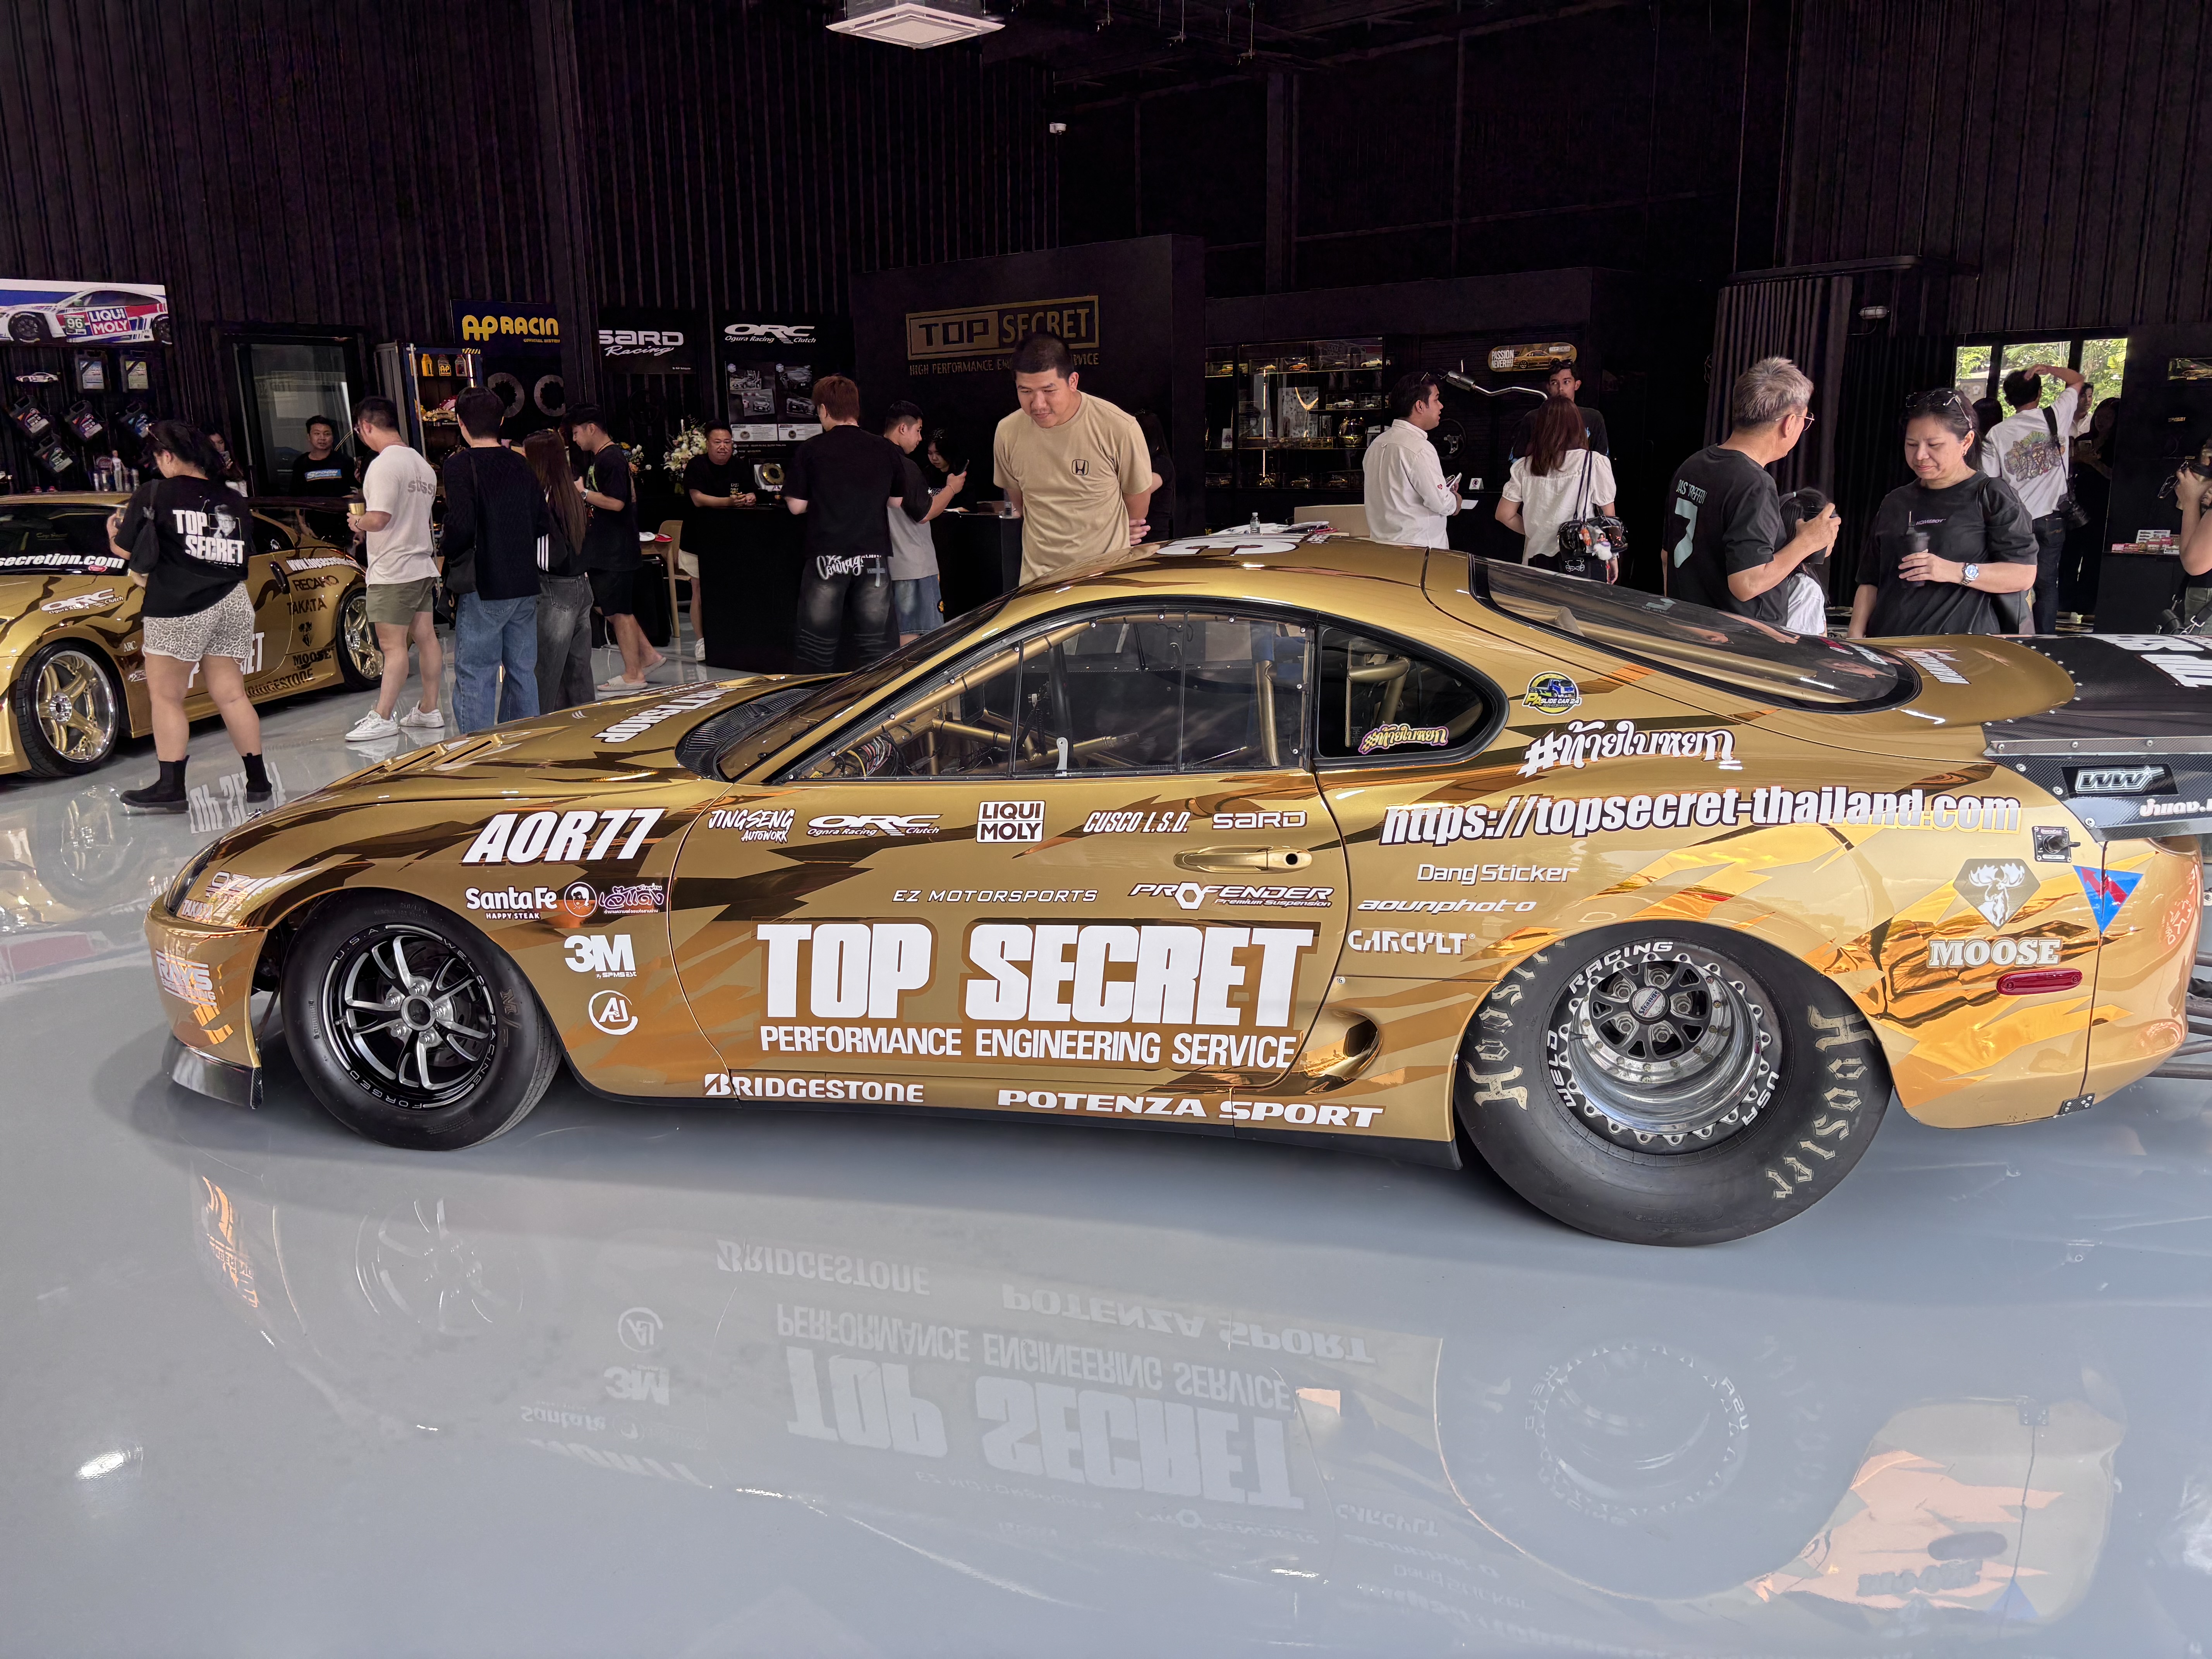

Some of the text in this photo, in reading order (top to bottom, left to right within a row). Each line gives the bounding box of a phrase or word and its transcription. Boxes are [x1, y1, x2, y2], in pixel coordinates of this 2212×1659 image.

[67, 318, 83, 329] 96
[89, 308, 126, 322] LIQUI
[92, 320, 128, 335] MOLY
[462, 315, 559, 341] AP RACIN
[725, 324, 815, 338] ORC
[919, 308, 1090, 346] TOP SECRET
[604, 345, 675, 356] Racing
[1492, 350, 1514, 360] PASSION
[910, 364, 929, 376] HIGH
[932, 360, 994, 374] PERFORMANCE
[1491, 359, 1506, 368] NEVER
[1676, 479, 1688, 495] DAS
[172, 510, 208, 536] TOP
[1674, 497, 1698, 568] 7
[185, 535, 245, 564] SECRET
[291, 575, 340, 592] RECARO
[287, 598, 328, 616] TAKATA
[124, 641, 137, 653] ARC
[292, 650, 332, 666] MOOSE
[708, 809, 795, 830] JINGSENG
[982, 803, 1042, 820] LIQUI
[1084, 811, 1193, 833] CUSCO L.S.D.
[1381, 786, 2021, 845] https://topsecret-thailand.com
[462, 808, 665, 864] AOR77
[808, 814, 943, 836] ORC
[841, 828, 878, 836] Racing
[906, 826, 940, 835] Clutch
[981, 822, 1041, 841] MOLY
[1416, 864, 1579, 885] Dang Sticker
[893, 889, 1098, 902] EZ MOTORSPORTS
[1263, 899, 1331, 908] Suspension
[1357, 898, 1537, 914] aounphoto
[563, 934, 636, 972] 3M
[1928, 939, 2061, 967] MOOSE
[156, 956, 213, 991] RAYS
[757, 923, 1314, 1027] TOP SECRET
[443, 938, 496, 1085] WELD RACING
[1638, 990, 1658, 1014] Strange
[1547, 941, 1673, 1109] WELD RACING
[760, 1025, 1297, 1069] PERFORMANCE ENGINEERING SERVICE
[349, 1069, 423, 1109] FORGED
[704, 1073, 925, 1103] BRIDGESTONE
[998, 1089, 1383, 1130] POTENZA SPORT
[1741, 1072, 1780, 1127] USA
[1767, 1004, 1882, 1200] Hoosier
